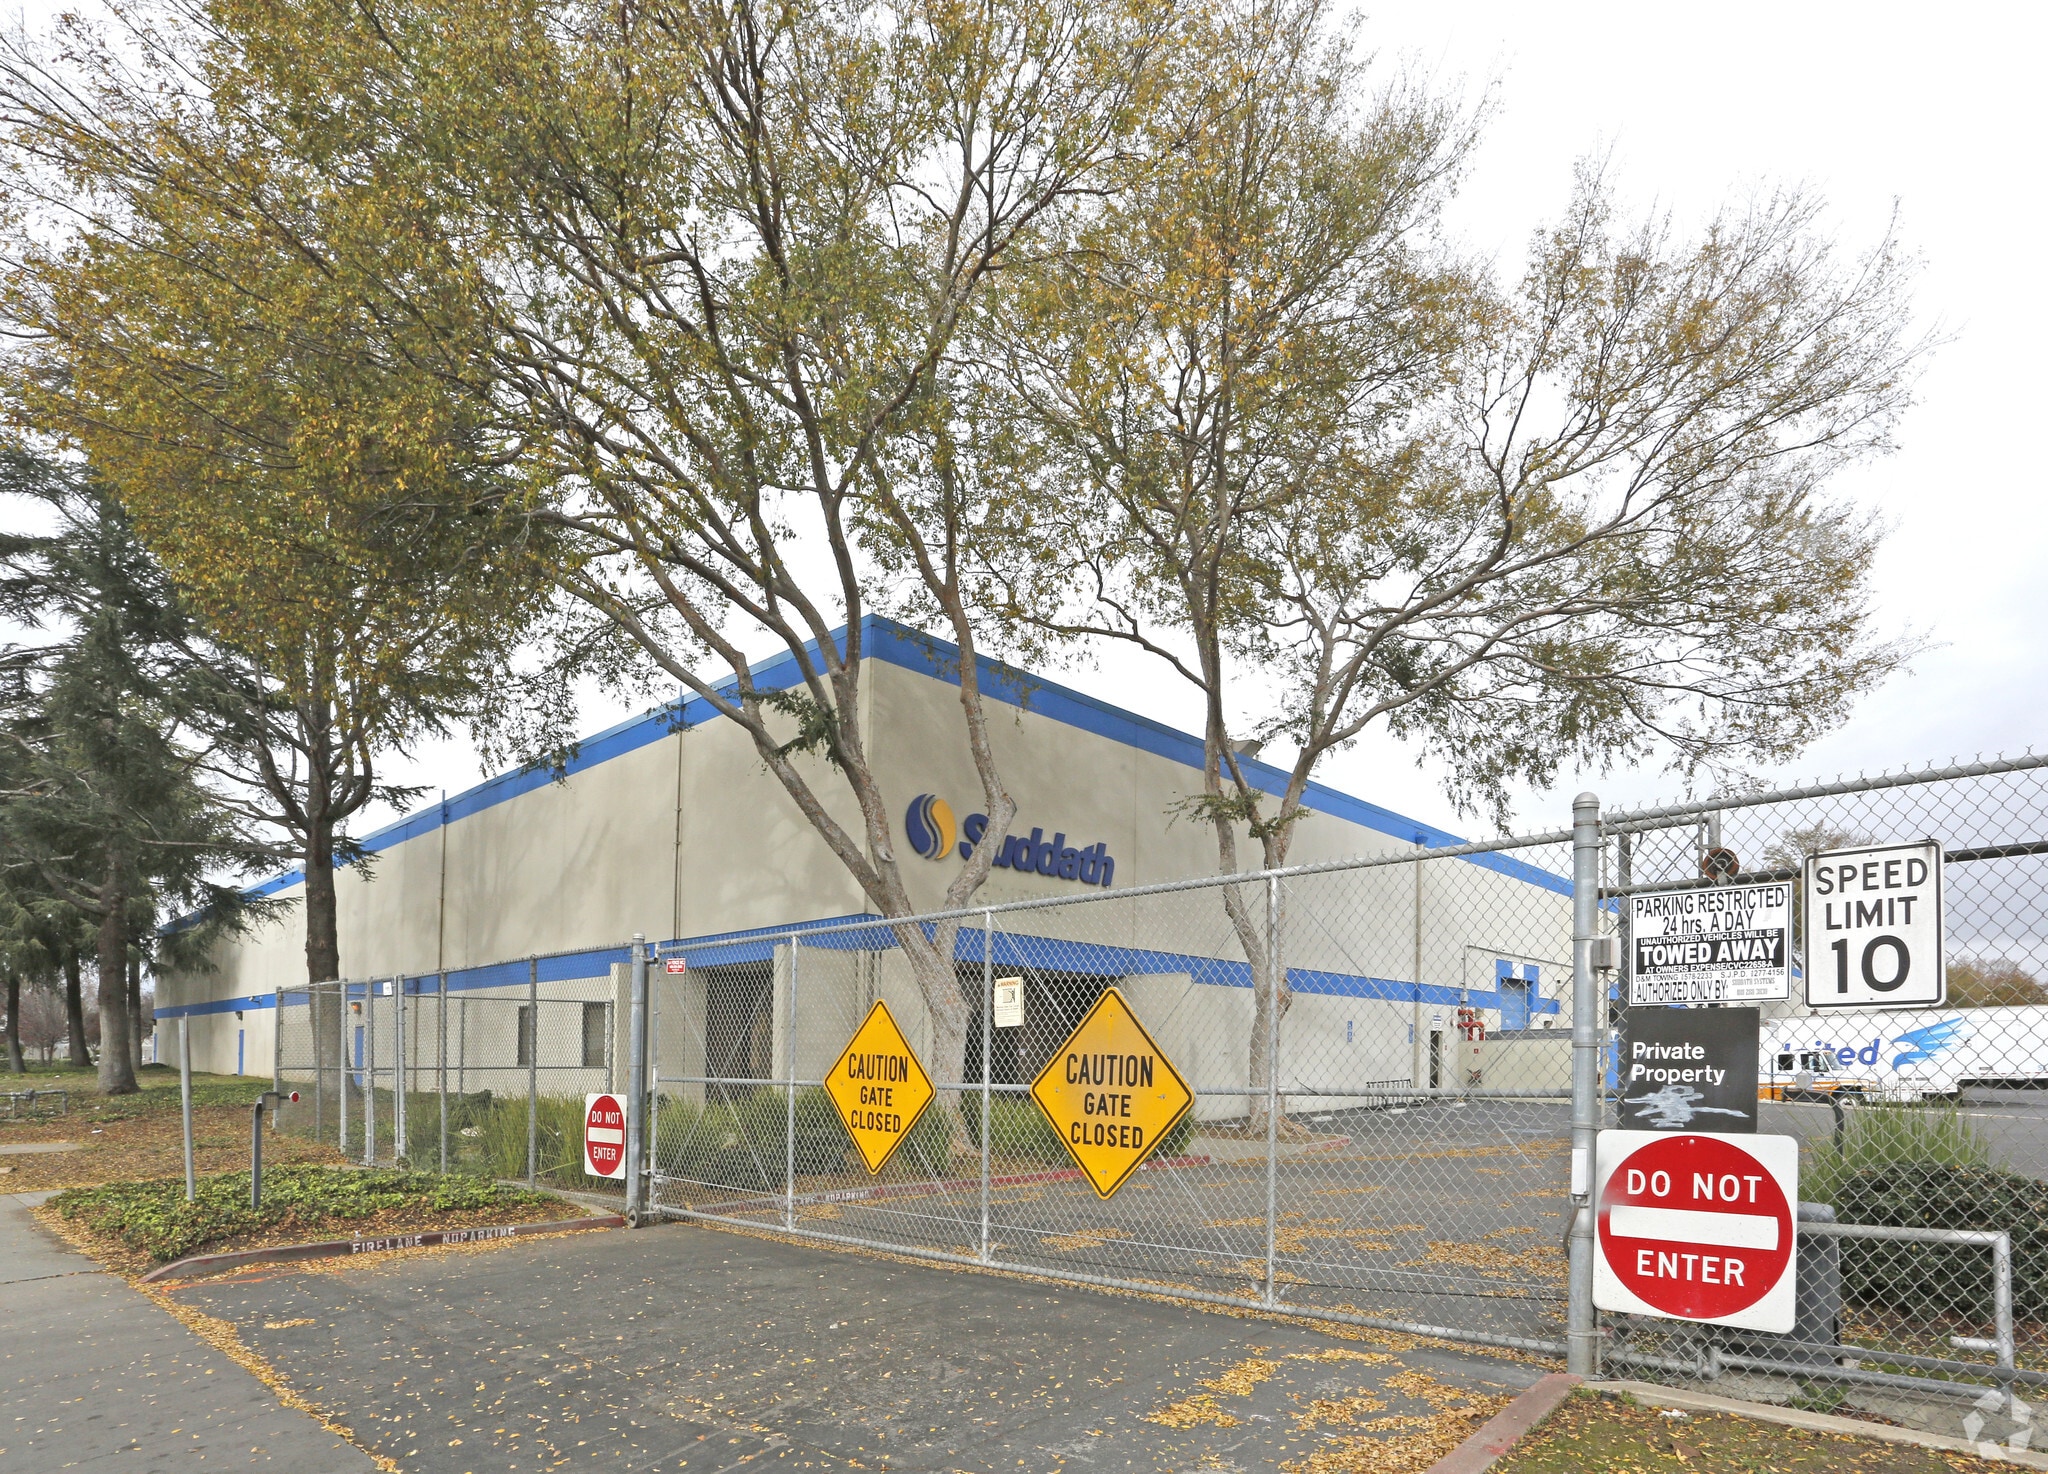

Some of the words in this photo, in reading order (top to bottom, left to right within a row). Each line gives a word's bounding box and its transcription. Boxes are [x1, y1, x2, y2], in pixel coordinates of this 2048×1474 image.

[959, 813, 1115, 887] Suddath
[1816, 858, 1928, 895] SPEED
[1636, 895, 1694, 918] PARKING
[1698, 887, 1784, 913] RESTRICTED
[1826, 896, 1918, 930] LIMIT
[1663, 916, 1677, 936] 24
[1681, 915, 1706, 934] hrs.
[1710, 913, 1720, 932] A
[1725, 910, 1755, 931] DAY
[1640, 935, 1701, 946] UNAUTHORIZED
[1703, 932, 1743, 941] VEHICLES
[1744, 930, 1764, 938] WILL
[1766, 929, 1778, 937] BE
[1640, 942, 1711, 966] TOWED
[1717, 938, 1780, 962] AWAY
[1831, 935, 1911, 993] 10
[1645, 966, 1655, 974] AT
[1656, 964, 1689, 974] OWNERS
[1653, 973, 1679, 982] TOWING
[1636, 981, 1689, 1002] AUTHORIZED
[1691, 980, 1713, 1000] ONLY
[1632, 1041, 1705, 1060] Private
[848, 1053, 908, 1083] CAUTION
[1066, 1053, 1153, 1087] CAUTION
[1631, 1063, 1726, 1086] Property
[860, 1085, 893, 1107] GATE
[1084, 1092, 1132, 1117] GATE
[591, 1110, 602, 1123] DO
[605, 1111, 620, 1125] NOT
[851, 1109, 901, 1133] CLOSED
[1070, 1121, 1143, 1149] CLOSED
[593, 1146, 616, 1161] ENTER
[1627, 1168, 1671, 1197] DO
[1692, 1172, 1762, 1203] NOT
[1636, 1249, 1745, 1287] ENTER
